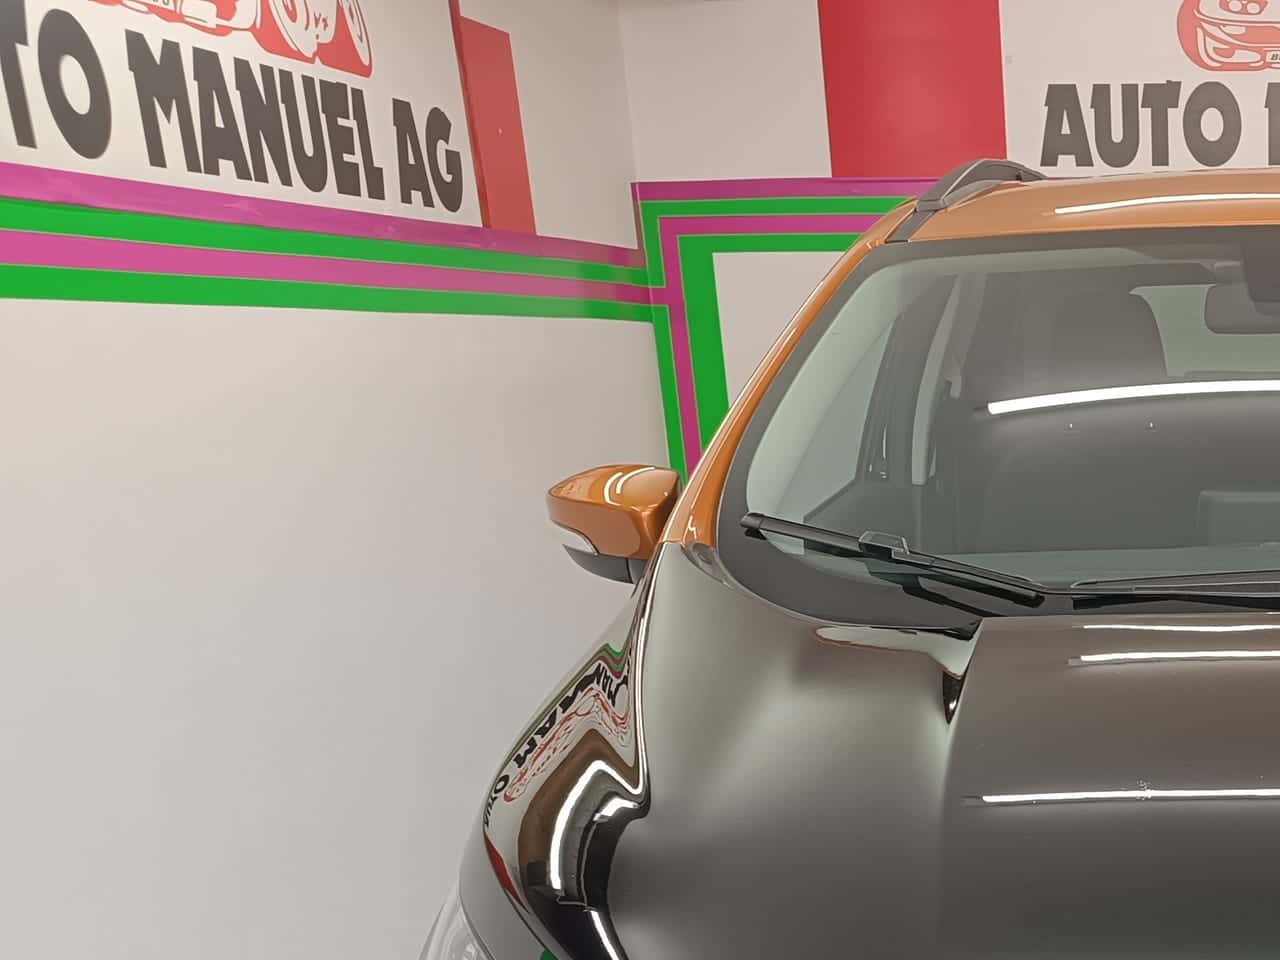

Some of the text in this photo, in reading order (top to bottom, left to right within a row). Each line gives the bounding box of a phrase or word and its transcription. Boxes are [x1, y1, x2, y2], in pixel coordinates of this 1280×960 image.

[126, 28, 386, 201] MANUEL
[392, 97, 464, 213] AG
[1040, 80, 1242, 168] AUTO
